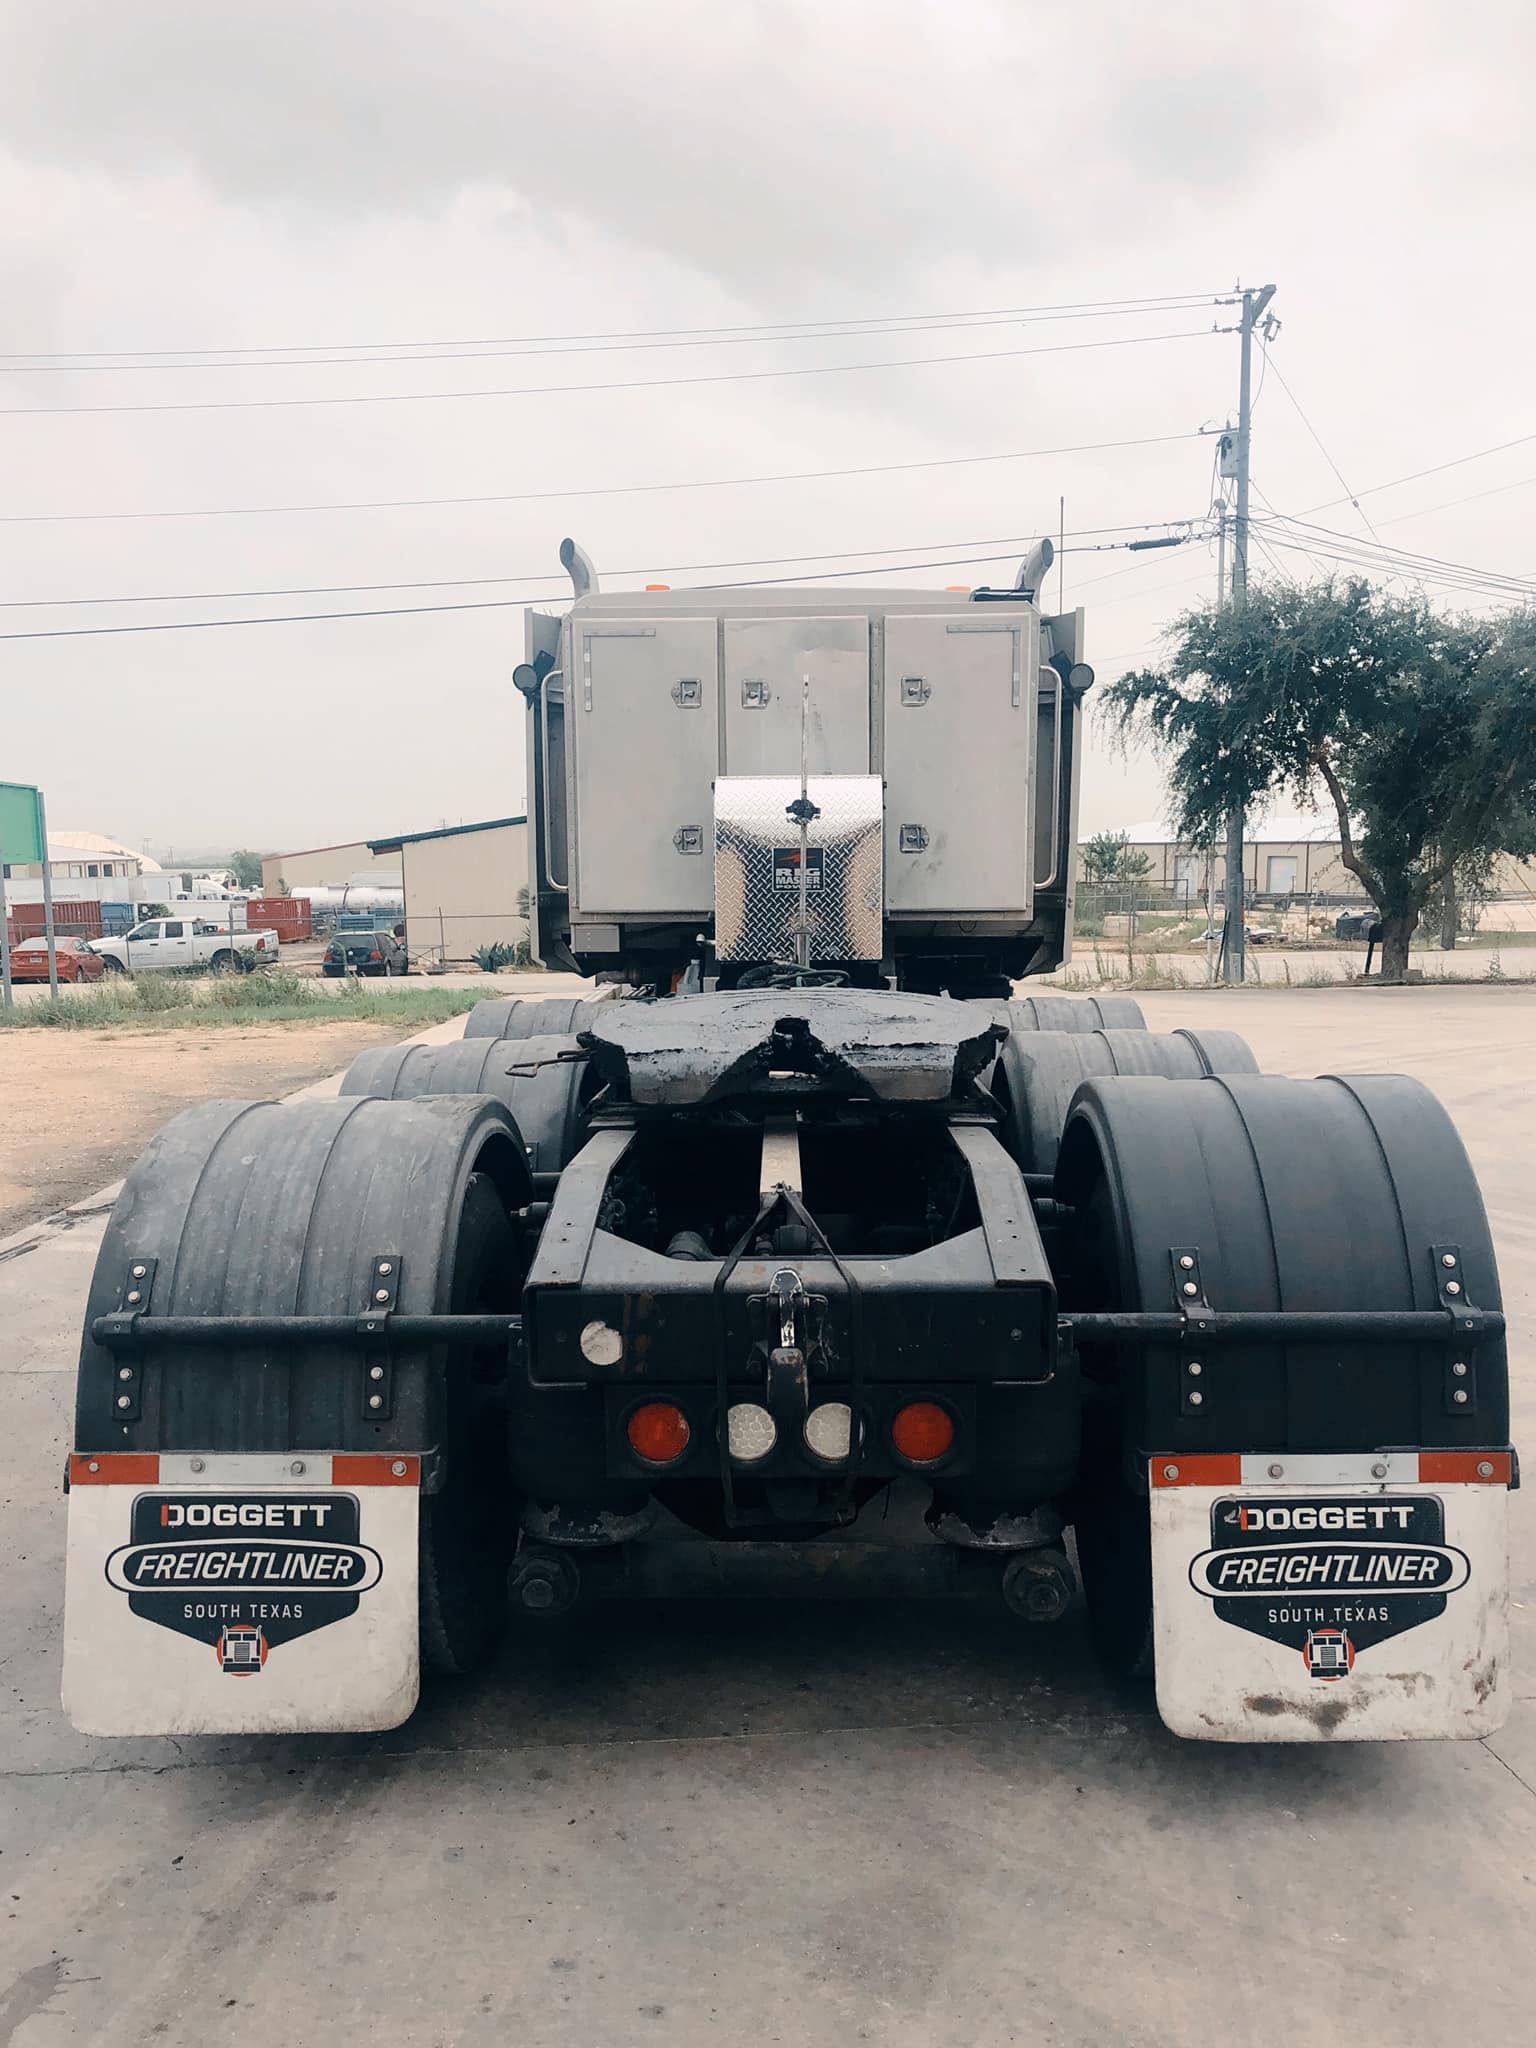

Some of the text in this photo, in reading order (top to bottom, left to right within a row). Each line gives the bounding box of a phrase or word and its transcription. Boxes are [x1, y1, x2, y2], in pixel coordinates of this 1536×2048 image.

[161, 1504, 331, 1527] DOGGETT
[1240, 1506, 1414, 1531] DOGGETT
[135, 1552, 354, 1580] FREIGHTLINER
[1218, 1555, 1440, 1585] FREIGHTLINER
[183, 1604, 303, 1619] SOUTH TEXAS
[1268, 1607, 1389, 1623] SOUTH TEXAS
